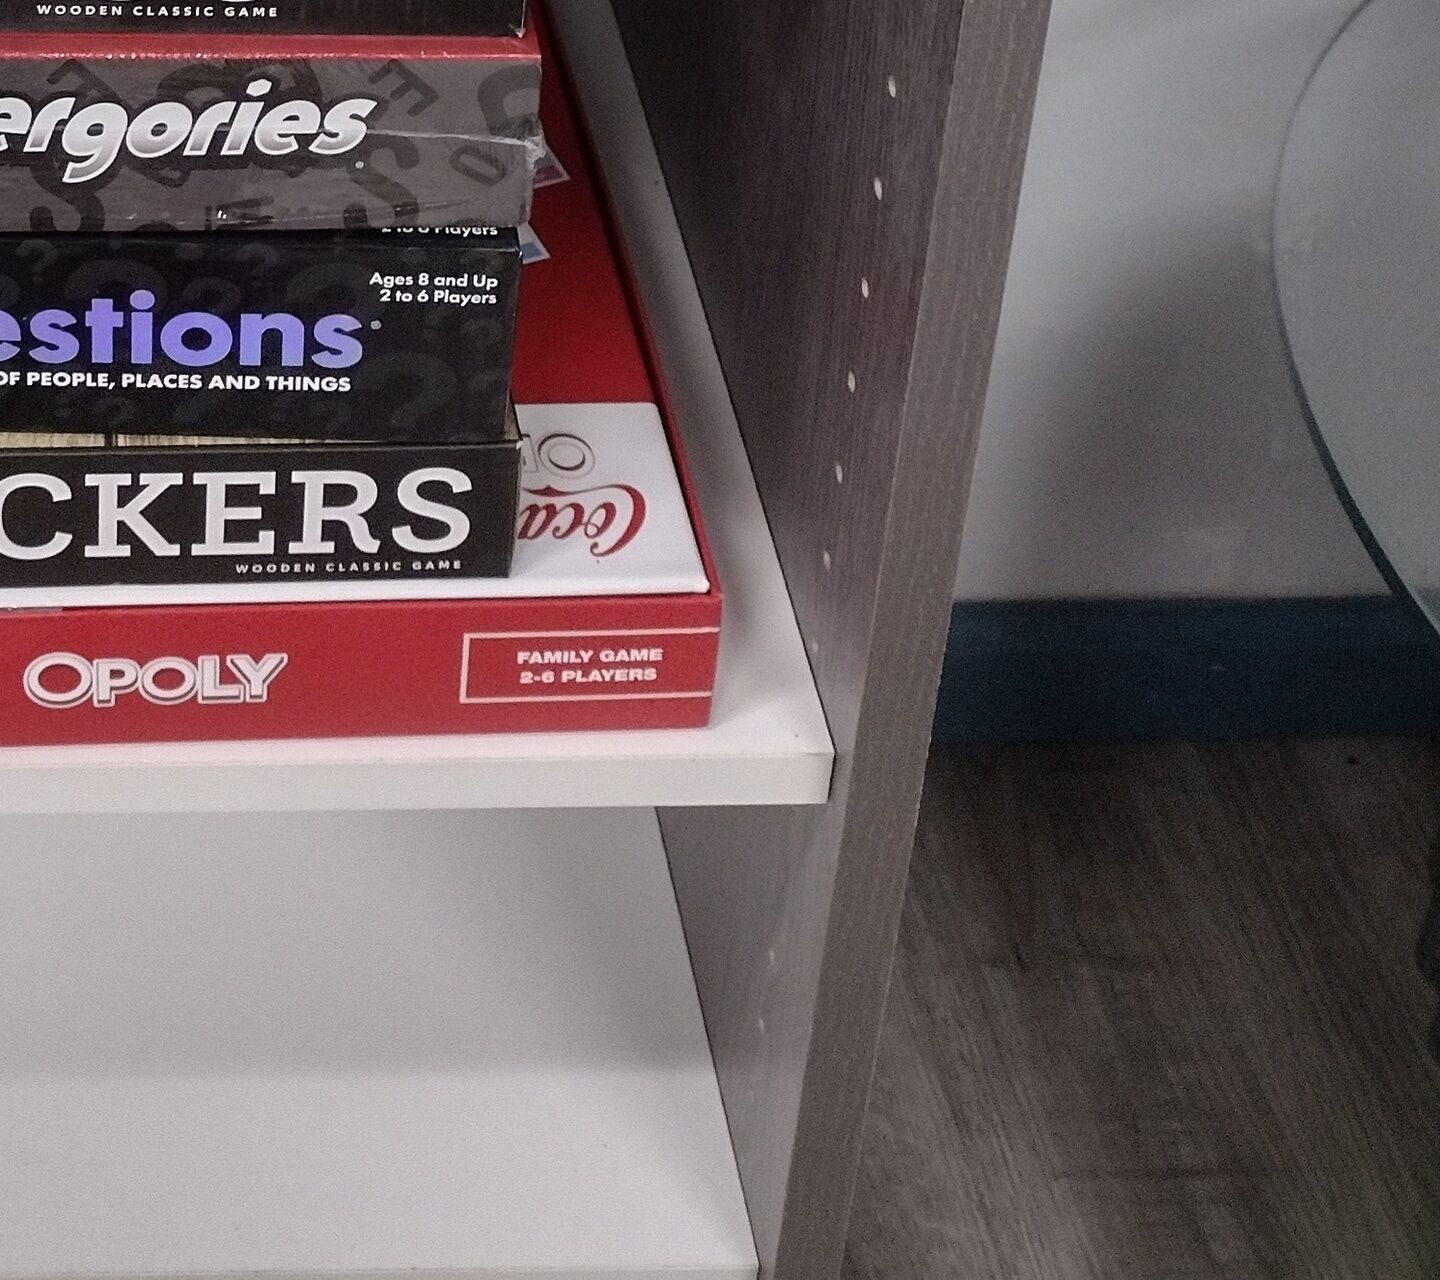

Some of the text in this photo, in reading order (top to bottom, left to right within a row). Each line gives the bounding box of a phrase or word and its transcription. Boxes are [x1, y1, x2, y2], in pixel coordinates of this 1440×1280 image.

[36, 4, 278, 18] WOODEN CLASSIC GAME
[369, 272, 499, 291] Ages 8 and Up
[379, 288, 497, 307] 2 to 6 Players
[26, 371, 115, 392] PEOPLE,
[121, 372, 203, 390] PLACES
[208, 373, 262, 391] AND
[266, 374, 352, 392] THINGS
[235, 559, 462, 573] WOODEN CLASSIC GAME
[516, 647, 663, 665] FAMILY GAME
[23, 652, 289, 710] OPOLY
[519, 666, 658, 685] 2-6 PLAYERS
